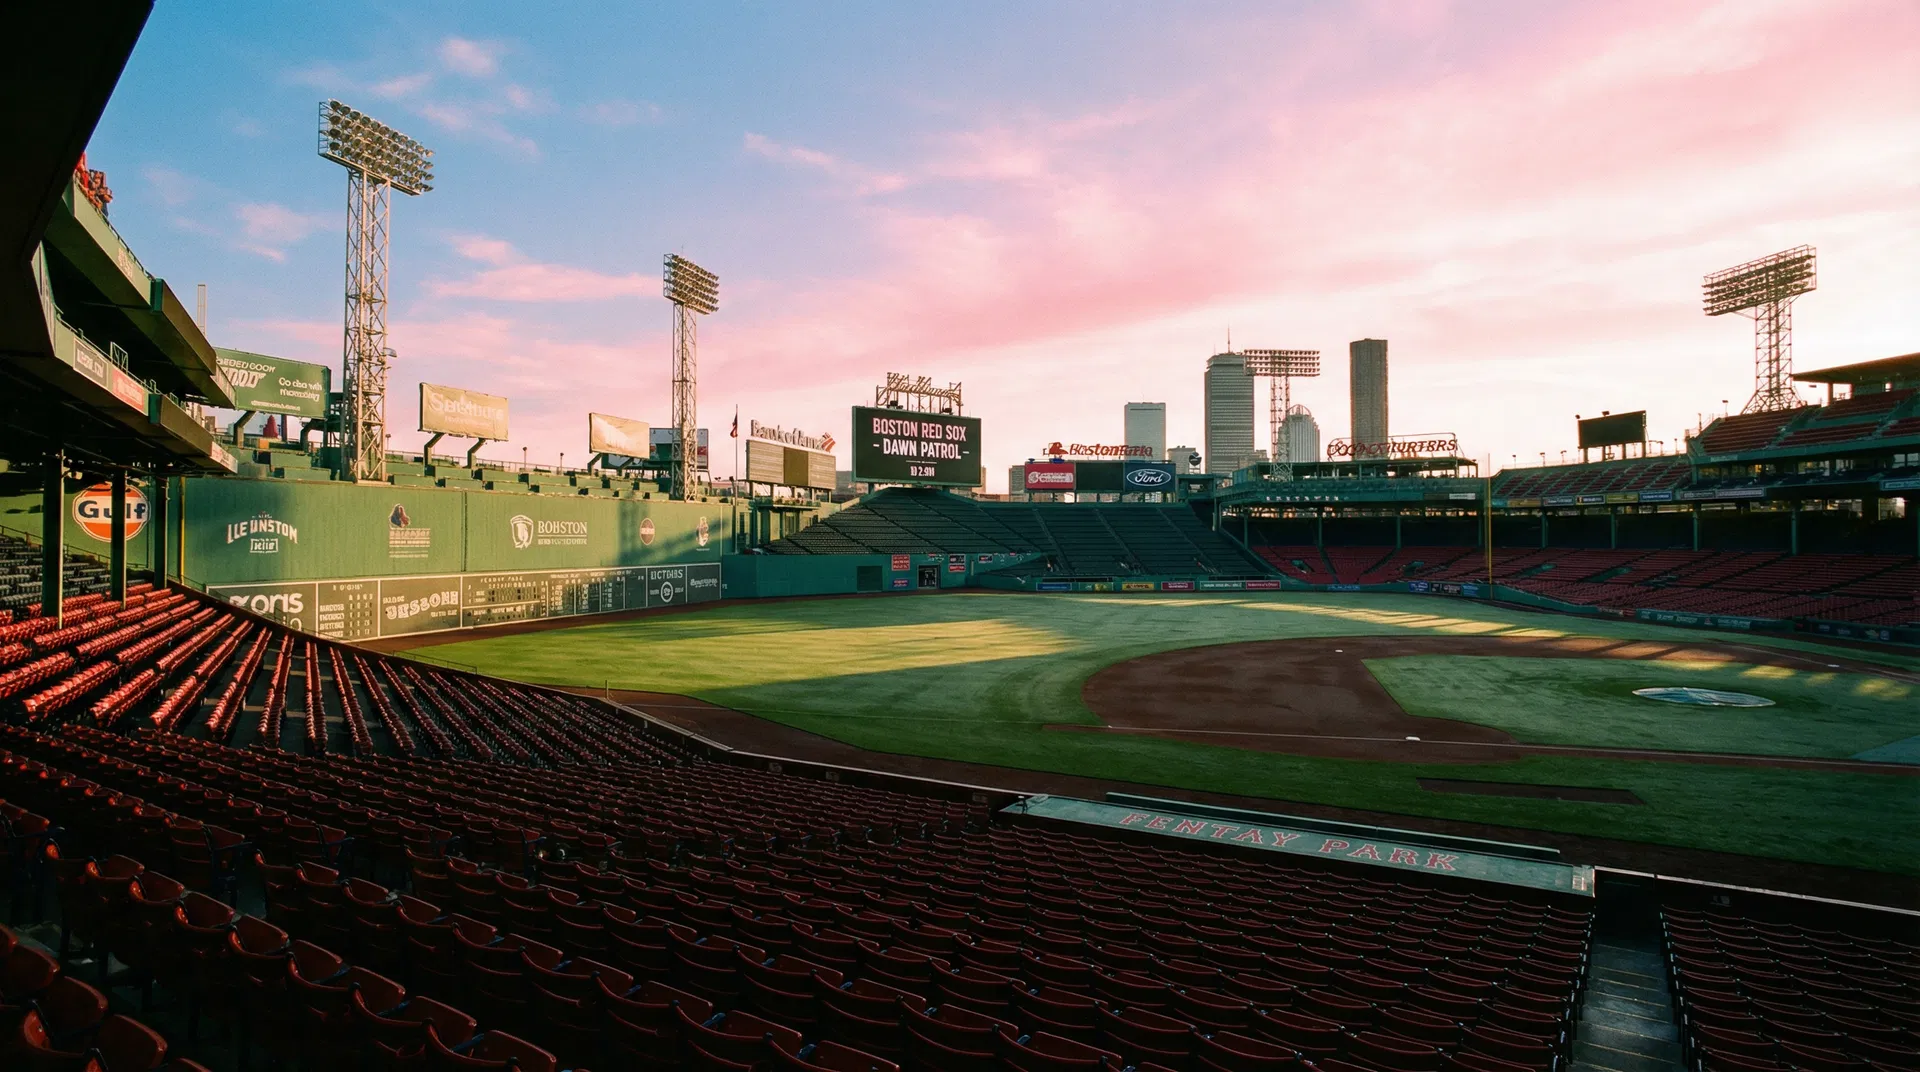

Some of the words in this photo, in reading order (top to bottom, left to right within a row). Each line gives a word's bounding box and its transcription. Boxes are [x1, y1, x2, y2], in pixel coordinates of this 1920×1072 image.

[872, 417, 918, 438] BOSTON
[921, 422, 943, 440] RED
[945, 425, 967, 442] SOX
[883, 438, 917, 457] DAWN
[920, 441, 962, 460] PATROL
[1118, 812, 1301, 848] FENTAY
[1318, 838, 1460, 872] PARK
